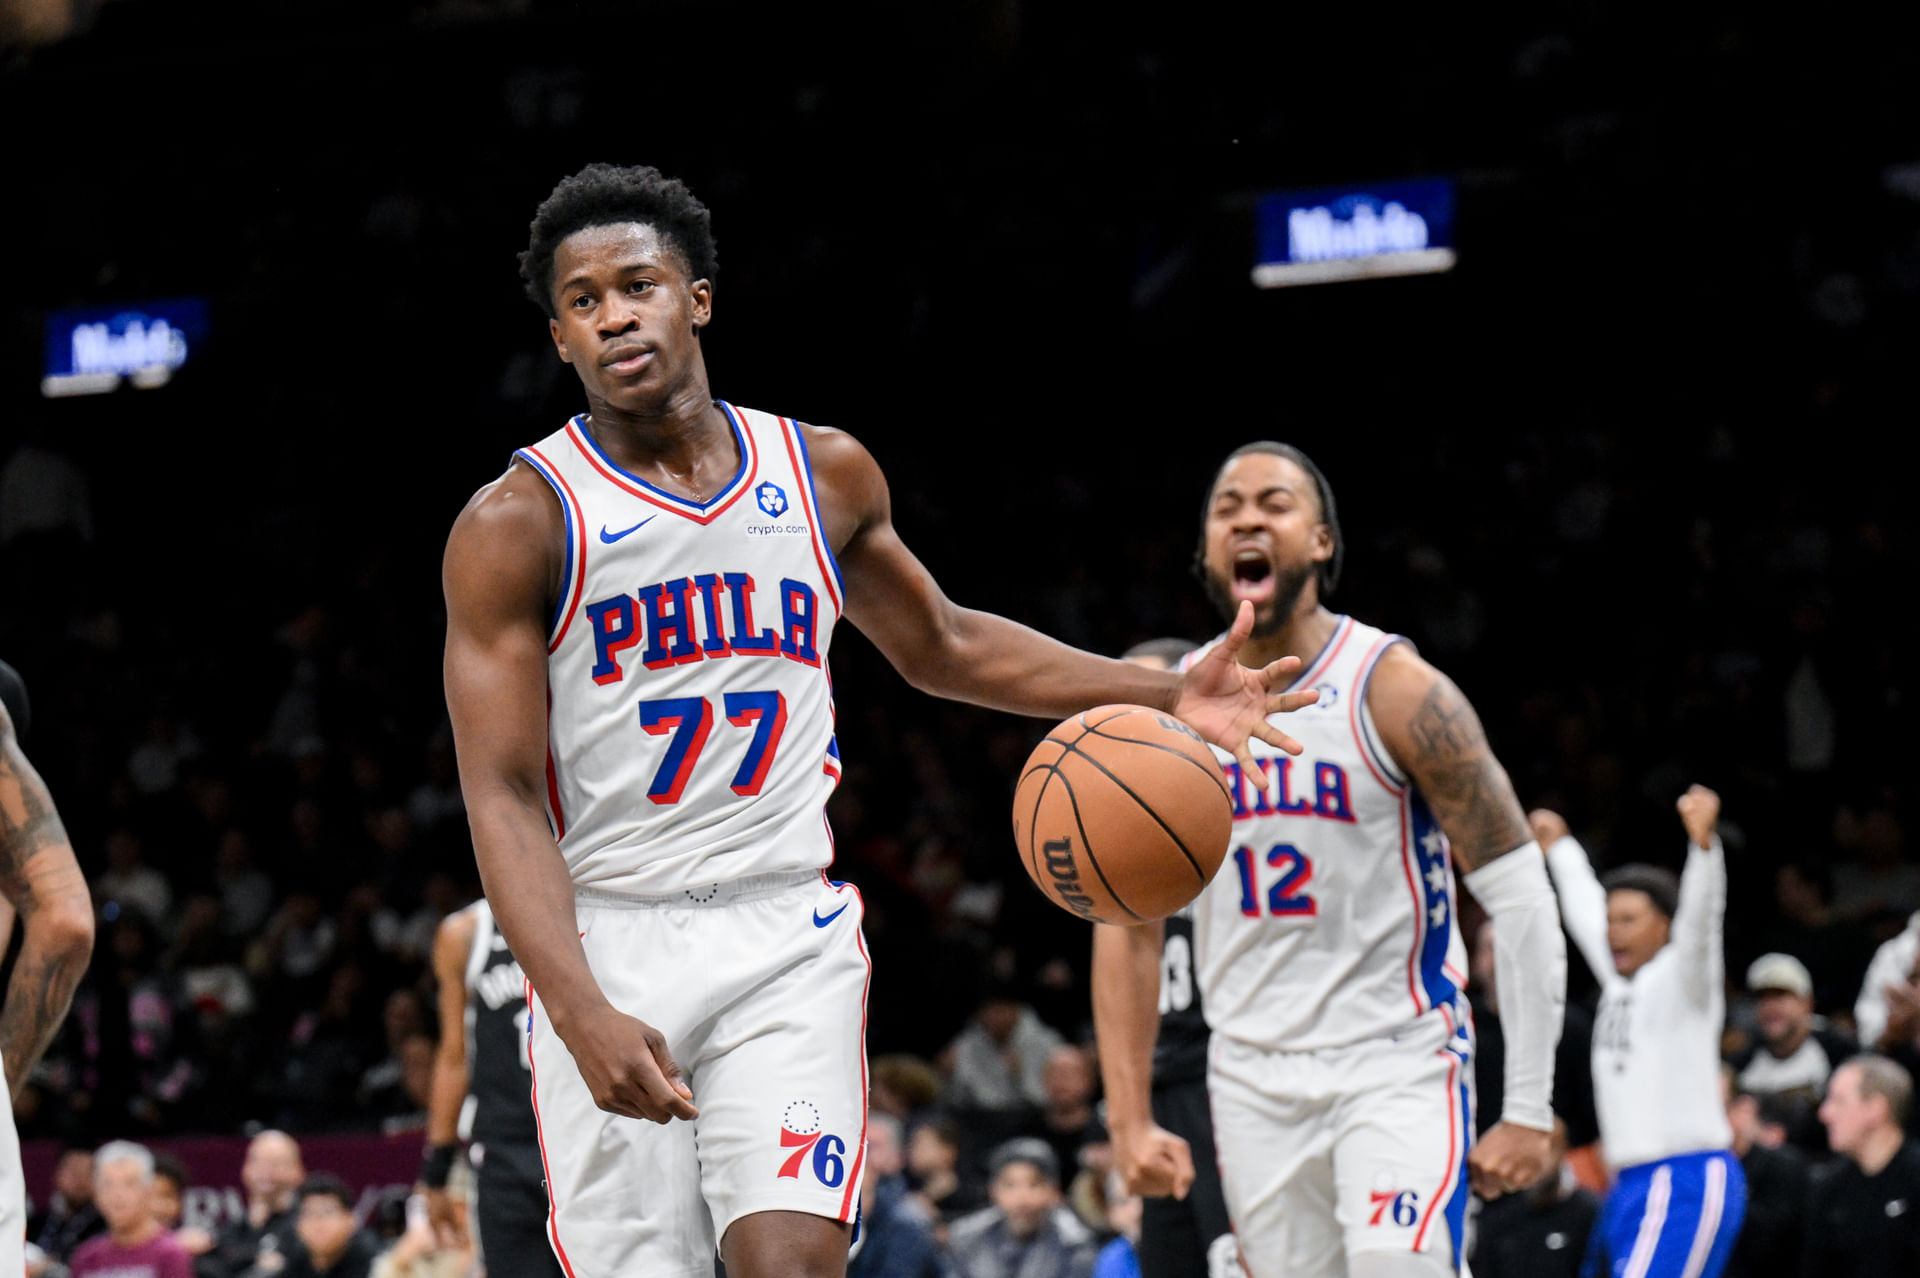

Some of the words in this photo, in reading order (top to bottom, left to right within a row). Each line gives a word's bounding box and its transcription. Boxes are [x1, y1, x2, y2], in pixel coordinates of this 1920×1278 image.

[747, 525, 808, 535] crypto.com
[586, 572, 821, 686] PHILA
[638, 690, 788, 804] 77
[1233, 844, 1318, 918] 12
[777, 1126, 846, 1188] 76
[1367, 1189, 1419, 1228] 76
